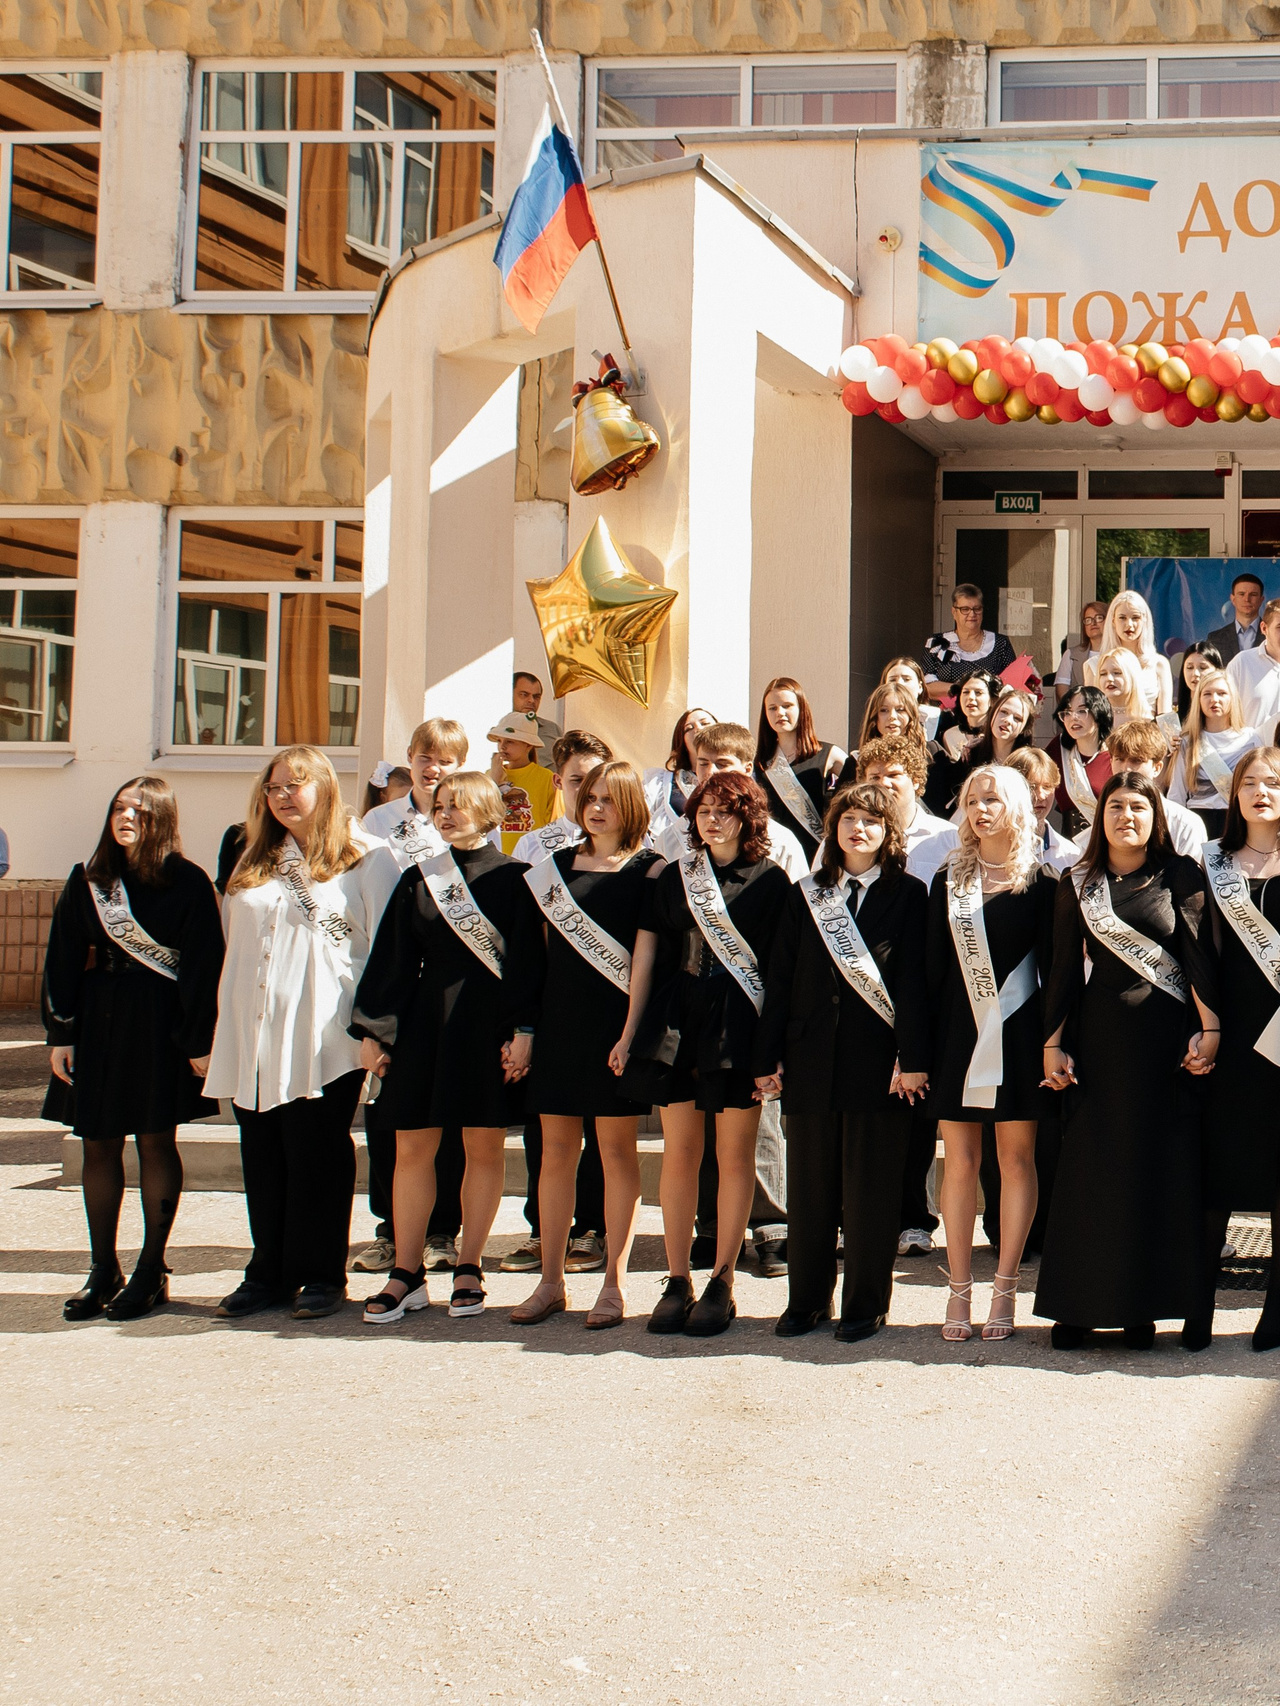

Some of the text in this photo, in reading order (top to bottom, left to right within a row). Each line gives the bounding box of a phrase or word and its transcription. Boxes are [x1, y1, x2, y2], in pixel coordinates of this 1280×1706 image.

[1002, 496, 1034, 511] ВХОД
[318, 912, 352, 941] 2025
[552, 903, 629, 981] Выпускник
[688, 879, 744, 967] Выпускник
[1087, 905, 1164, 980] Выпускник
[1213, 872, 1274, 960] Выпускник
[971, 967, 996, 998] 2025
